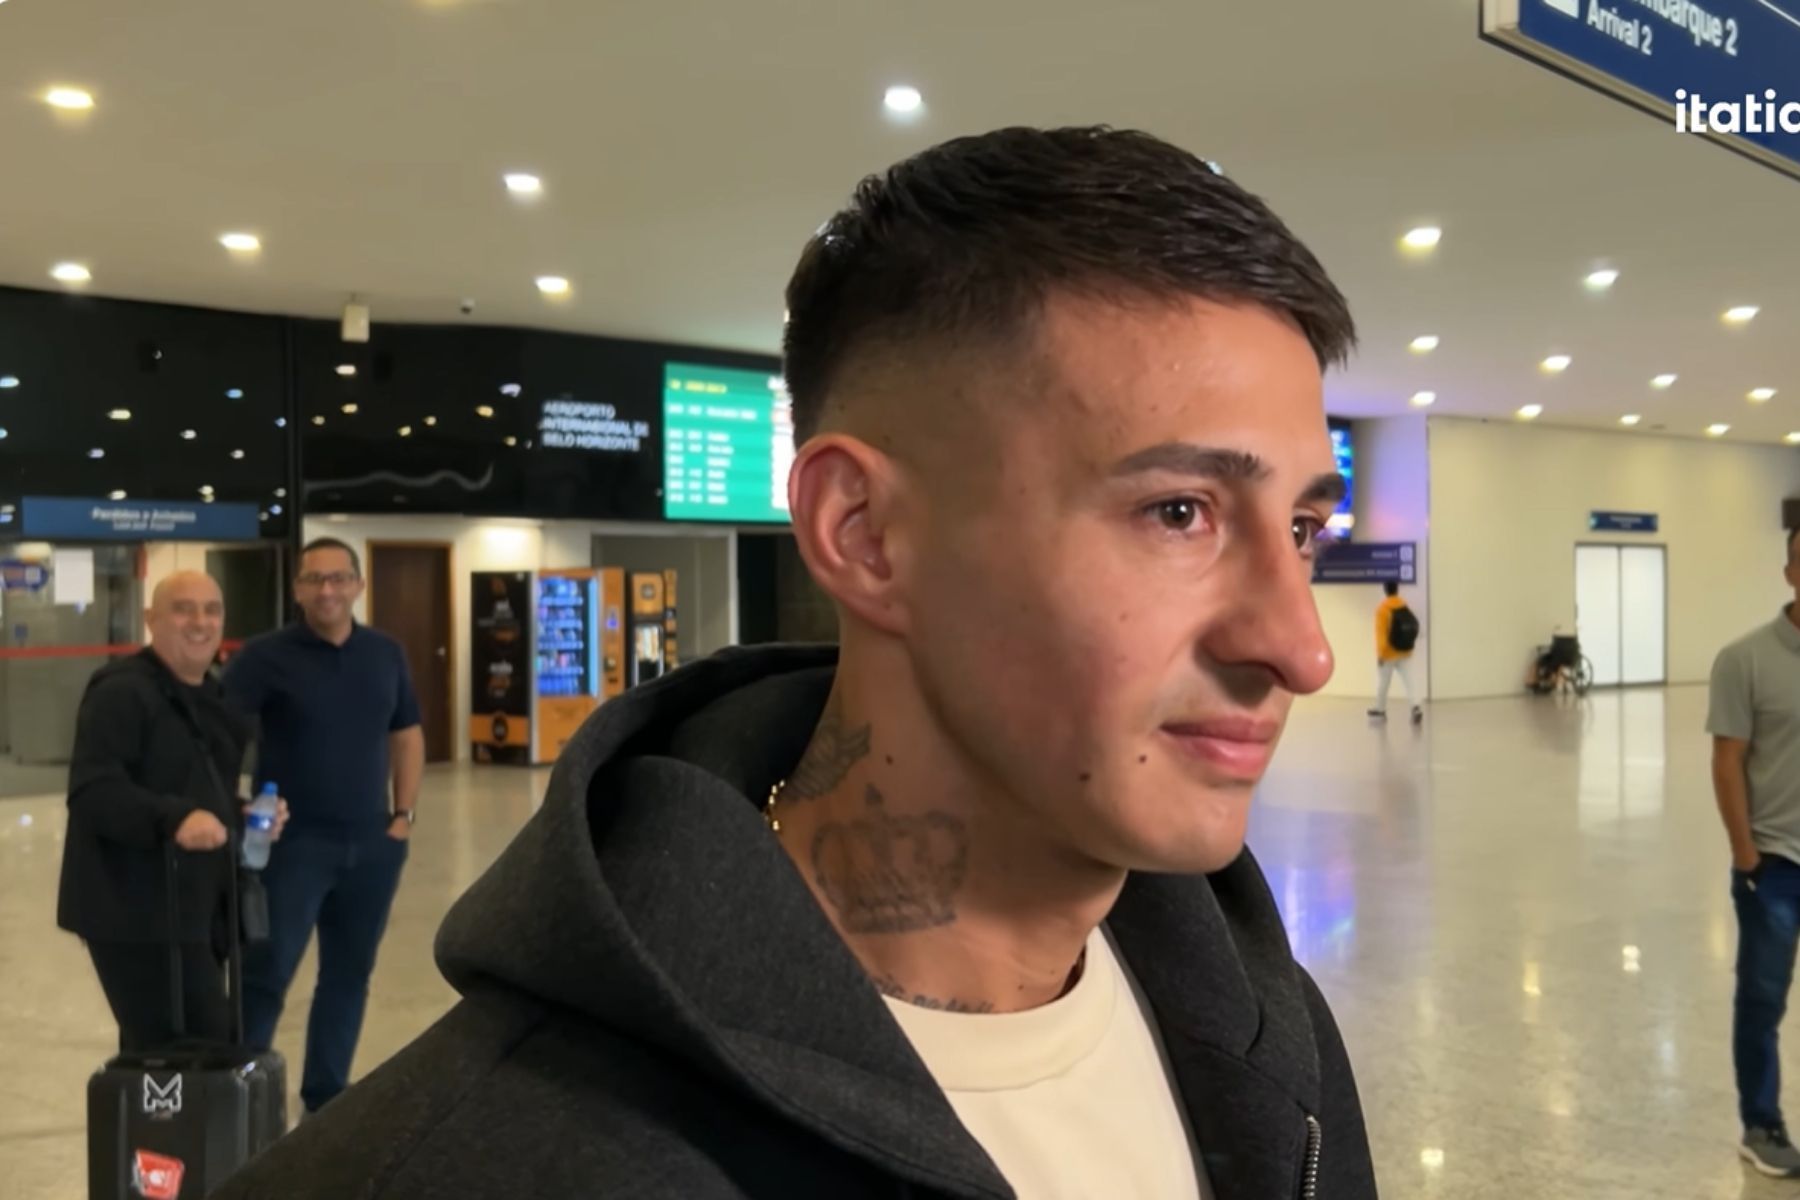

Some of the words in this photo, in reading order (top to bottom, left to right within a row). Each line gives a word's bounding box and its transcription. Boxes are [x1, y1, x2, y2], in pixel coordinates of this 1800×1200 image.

[1587, 0, 1639, 49] Arrival
[1641, 25, 1653, 55] 2
[1725, 18, 1738, 57] 2
